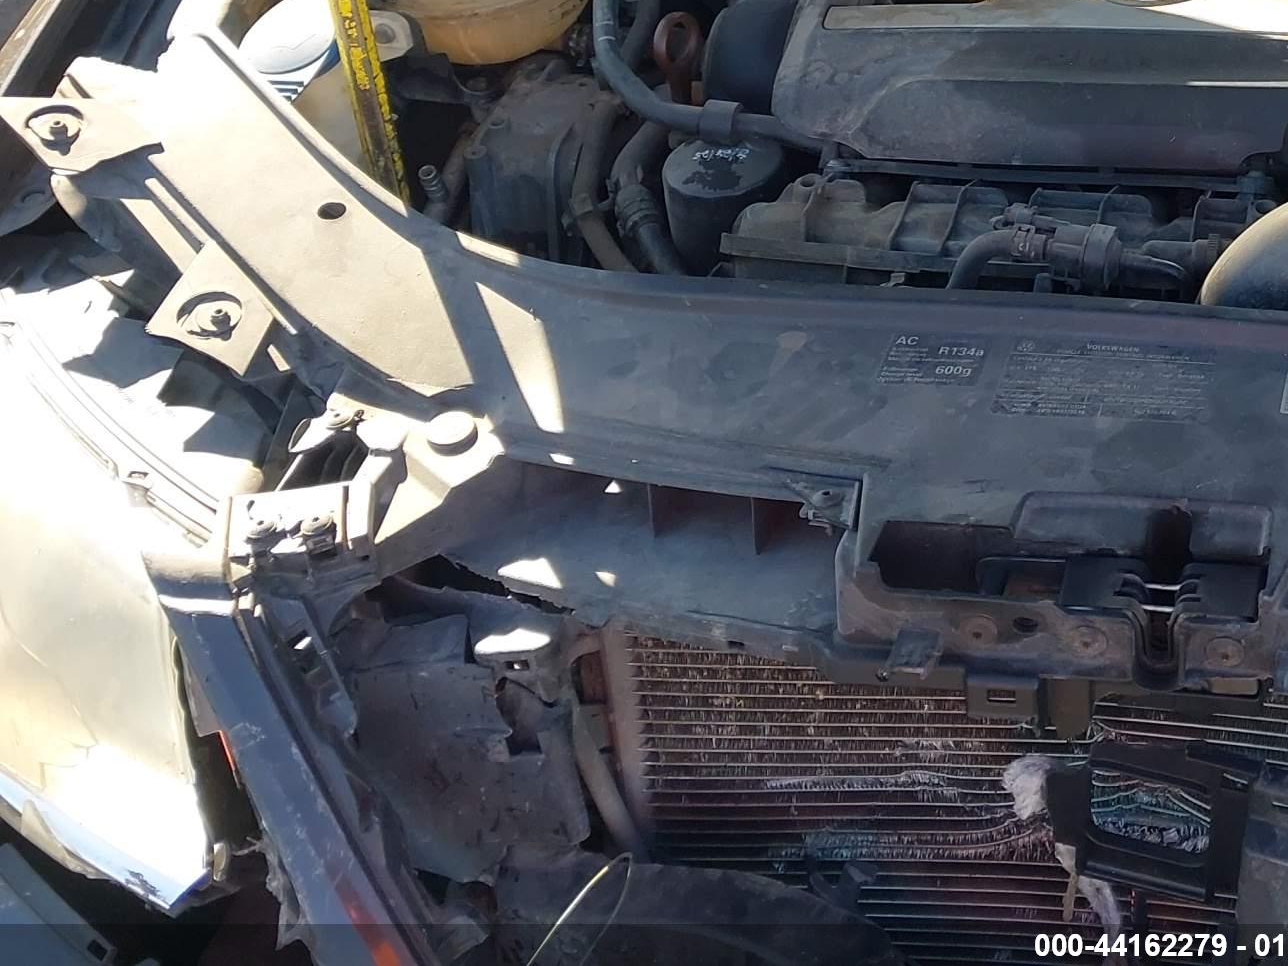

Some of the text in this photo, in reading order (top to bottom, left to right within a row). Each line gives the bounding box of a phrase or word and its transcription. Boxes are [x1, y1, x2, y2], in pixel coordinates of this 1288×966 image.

[895, 336, 920, 346] AC
[937, 345, 985, 357] R134a
[1086, 342, 1141, 354] VOLKSWAGEN
[934, 365, 973, 378] 600g
